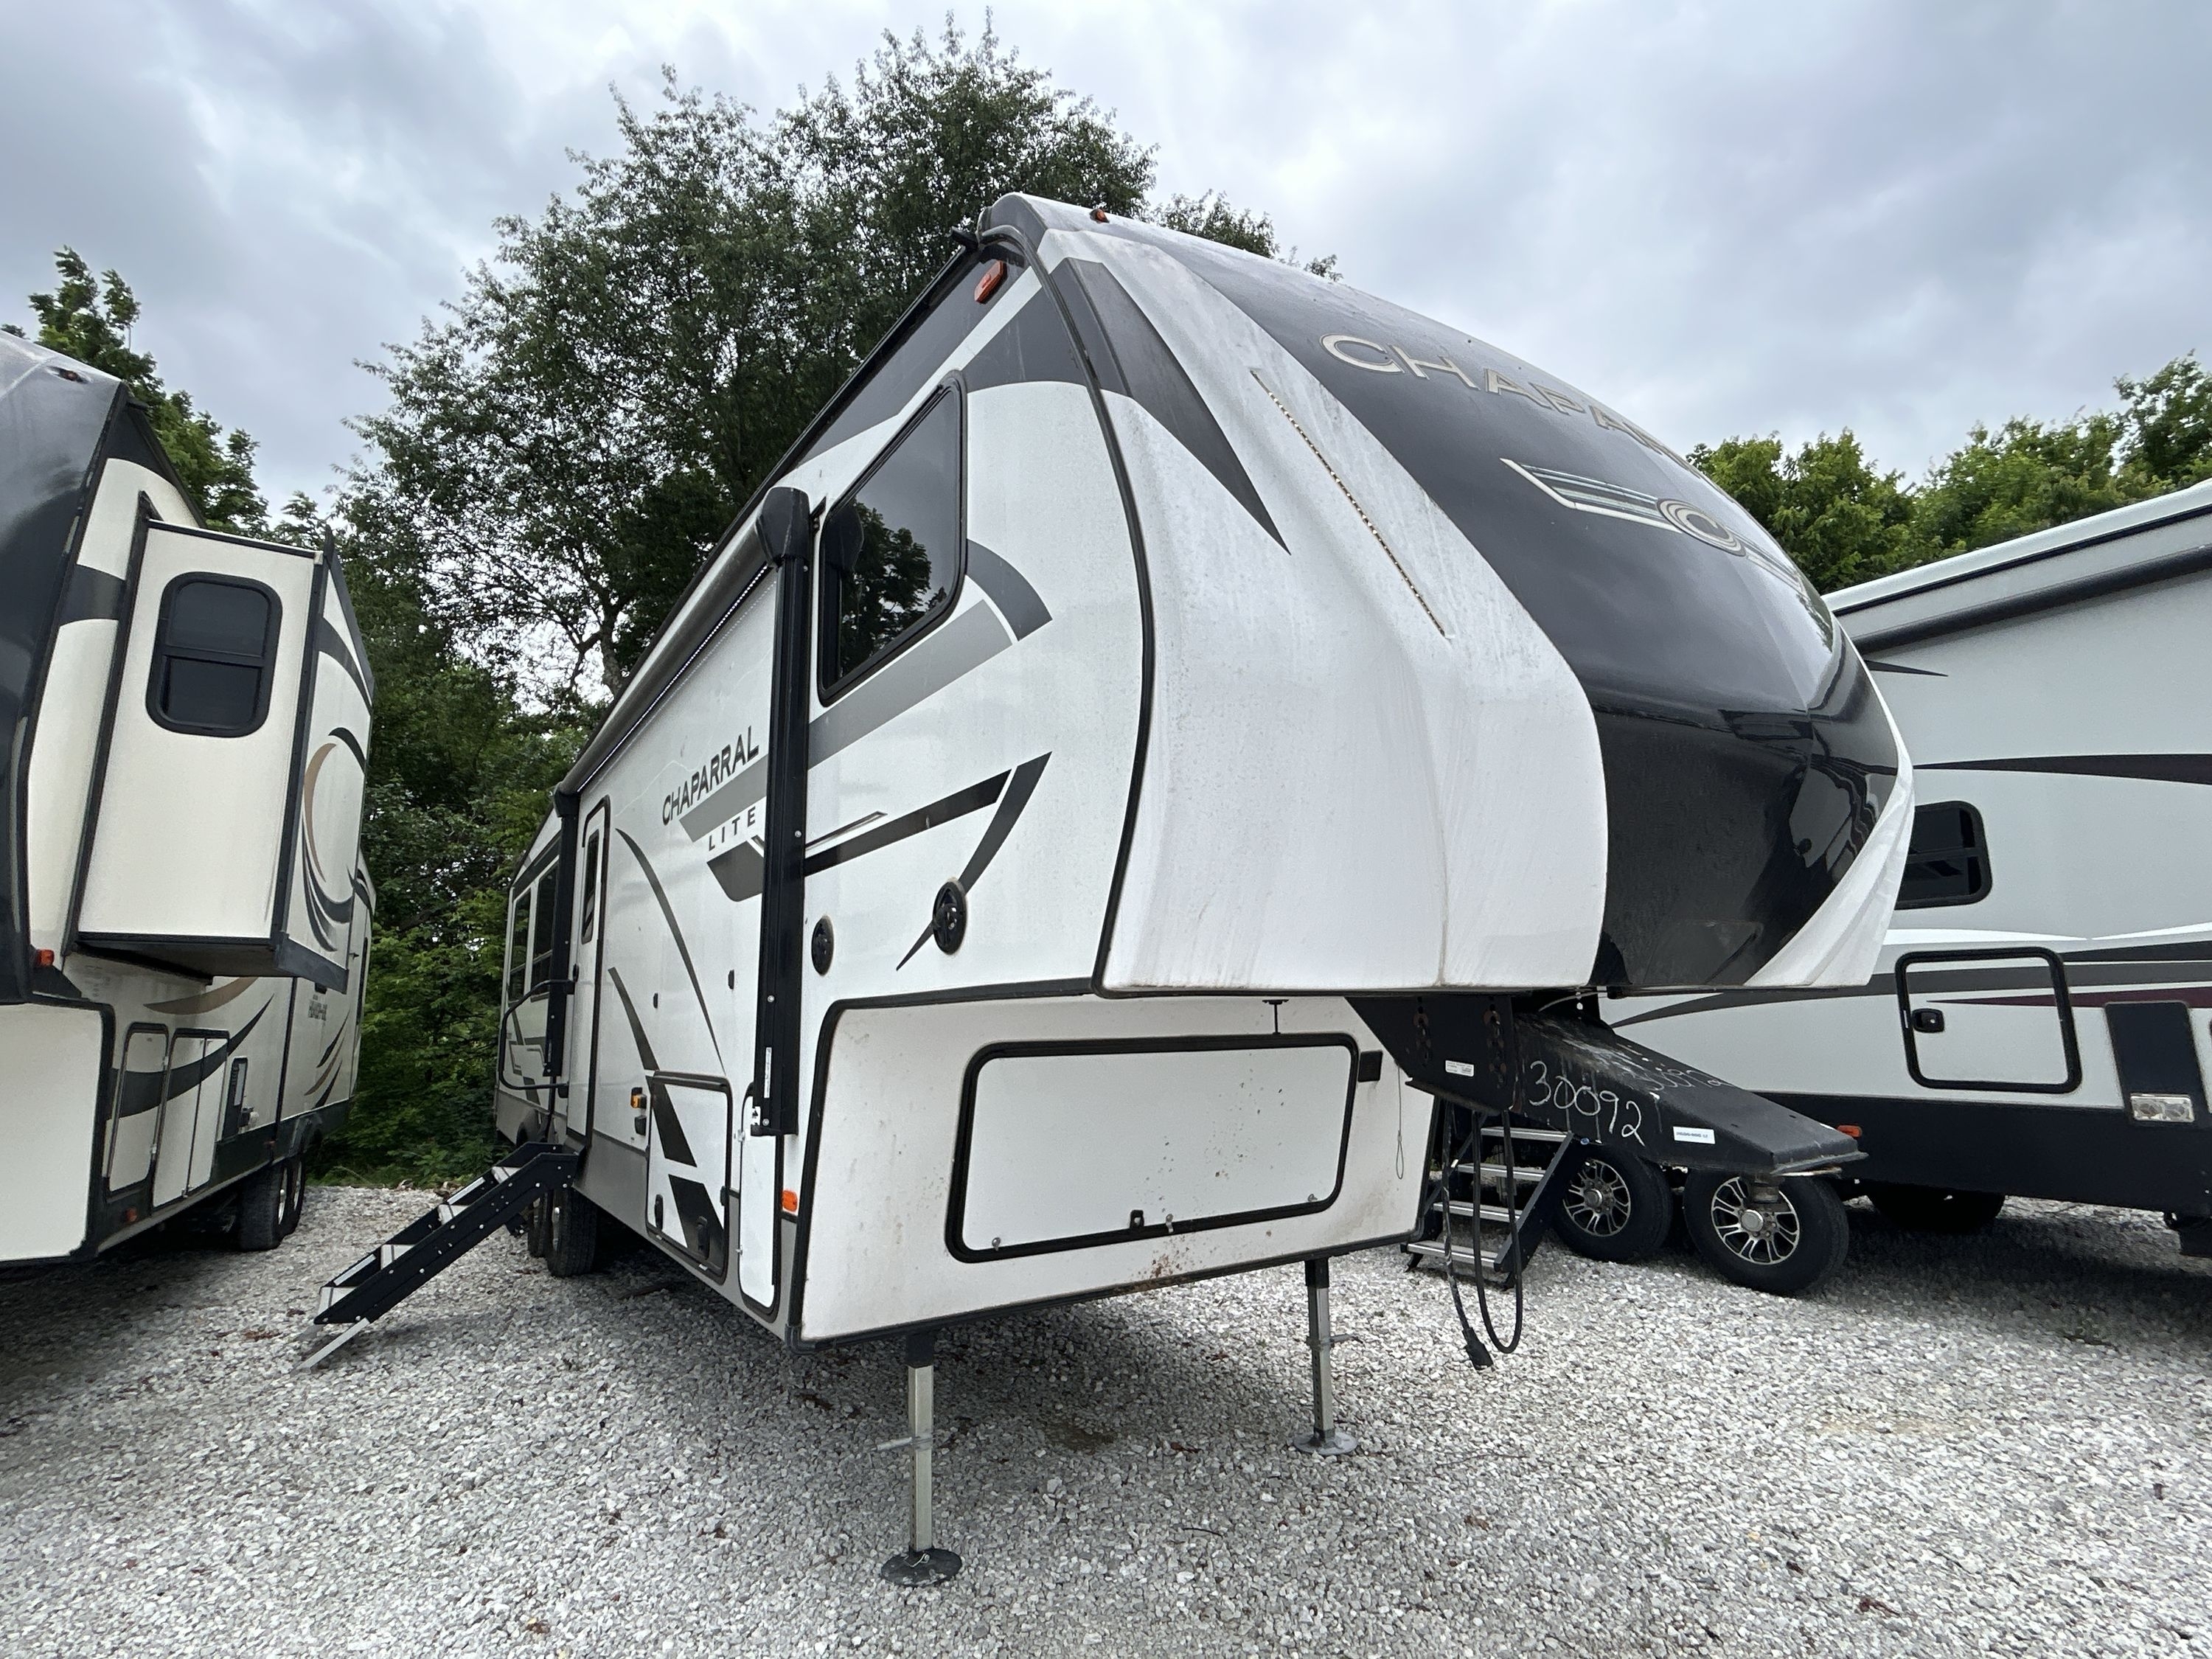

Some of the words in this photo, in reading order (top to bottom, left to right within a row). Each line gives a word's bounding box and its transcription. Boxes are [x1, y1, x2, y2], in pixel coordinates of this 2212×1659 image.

[662, 726, 759, 827] CHAPARRAL
[709, 806, 756, 852] LITE
[1528, 1060, 1646, 1147] 30092
